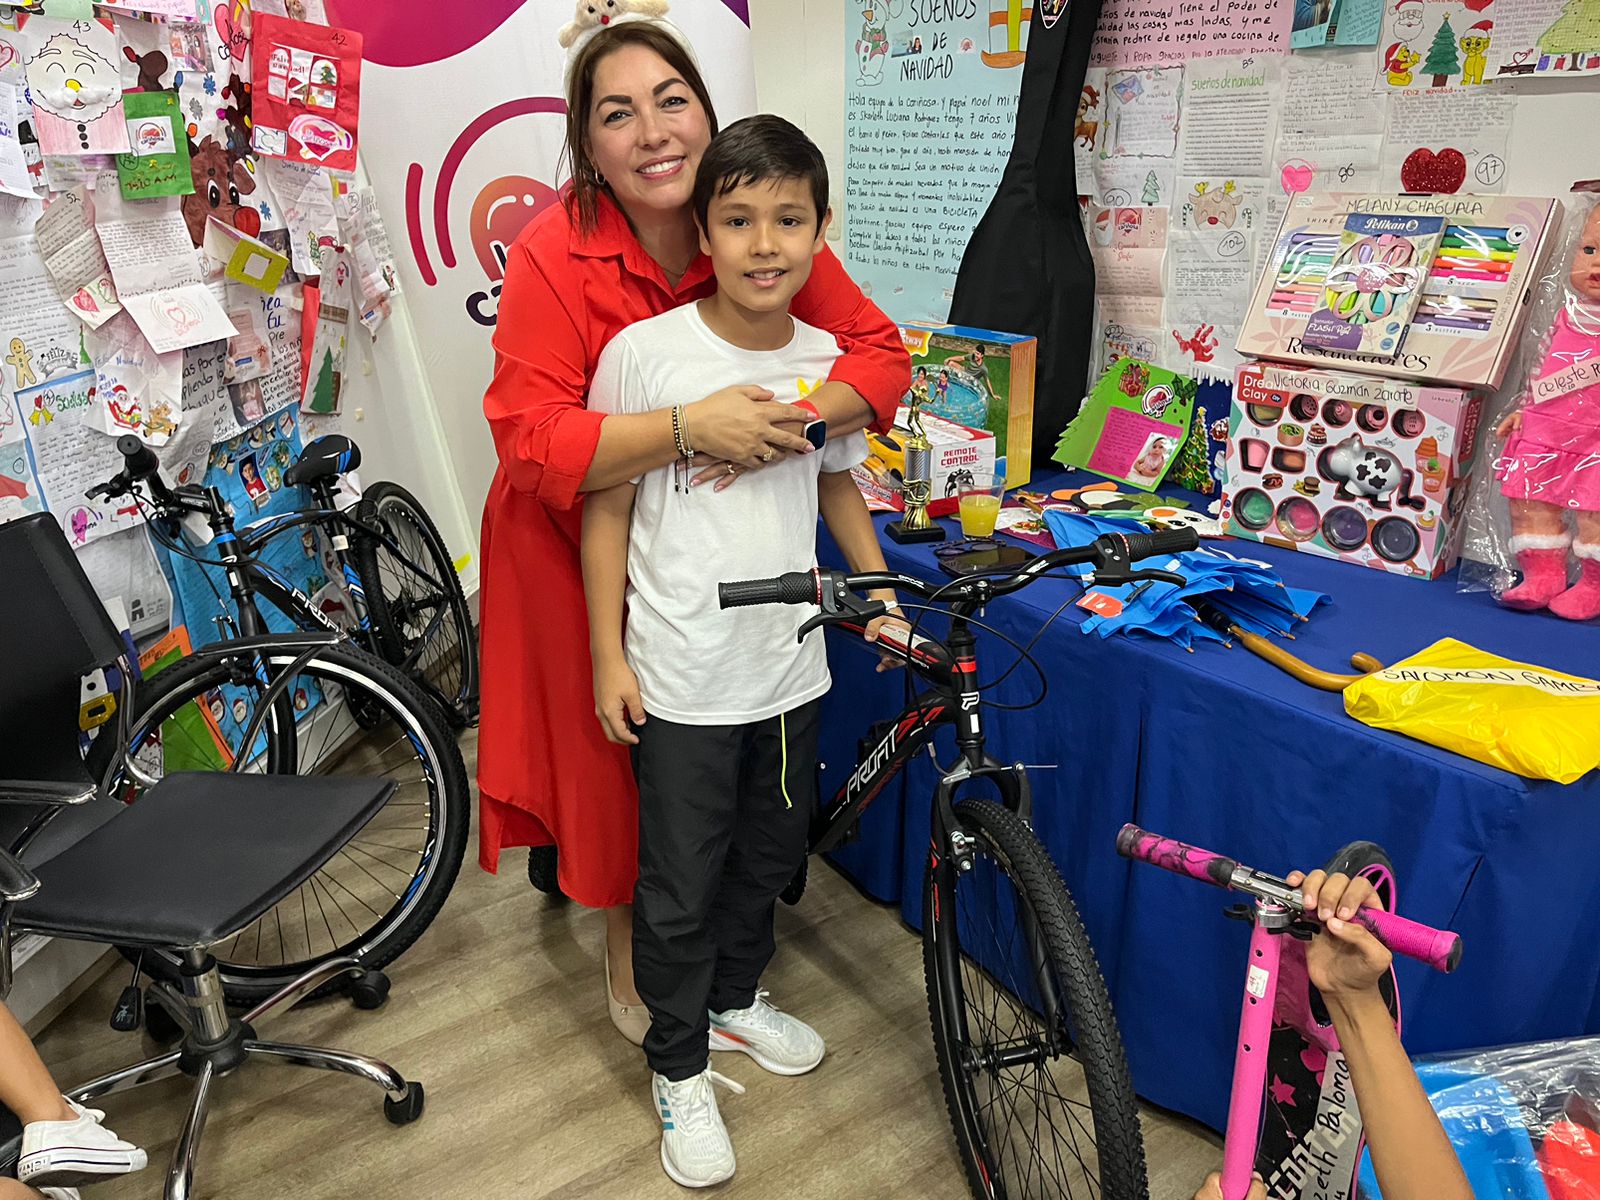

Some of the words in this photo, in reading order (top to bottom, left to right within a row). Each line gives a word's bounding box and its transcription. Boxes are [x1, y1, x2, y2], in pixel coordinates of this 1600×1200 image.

[1124, 7, 1135, 17] de
[1210, 0, 1219, 12] el
[1227, 1, 1256, 13] poder
[1265, 0, 1277, 9] de
[72, 19, 91, 33] 43
[1128, 22, 1139, 30] las
[1143, 21, 1167, 30] cosas
[1252, 16, 1271, 24] me
[331, 32, 347, 46] 42
[932, 32, 947, 51] DE
[1157, 32, 1170, 42] de
[1177, 30, 1207, 44] regalo
[1231, 32, 1263, 41] cocina
[1268, 31, 1280, 42] de
[901, 54, 953, 81] NAVIDAD
[849, 92, 866, 107] Hola
[1346, 199, 1401, 213] MELANY
[1406, 200, 1484, 215] CHAGUALA
[1364, 217, 1405, 231] Pelikan
[1242, 387, 1267, 401] Clay
[943, 446, 977, 457] REMOTE
[940, 455, 980, 466] CONTROL
